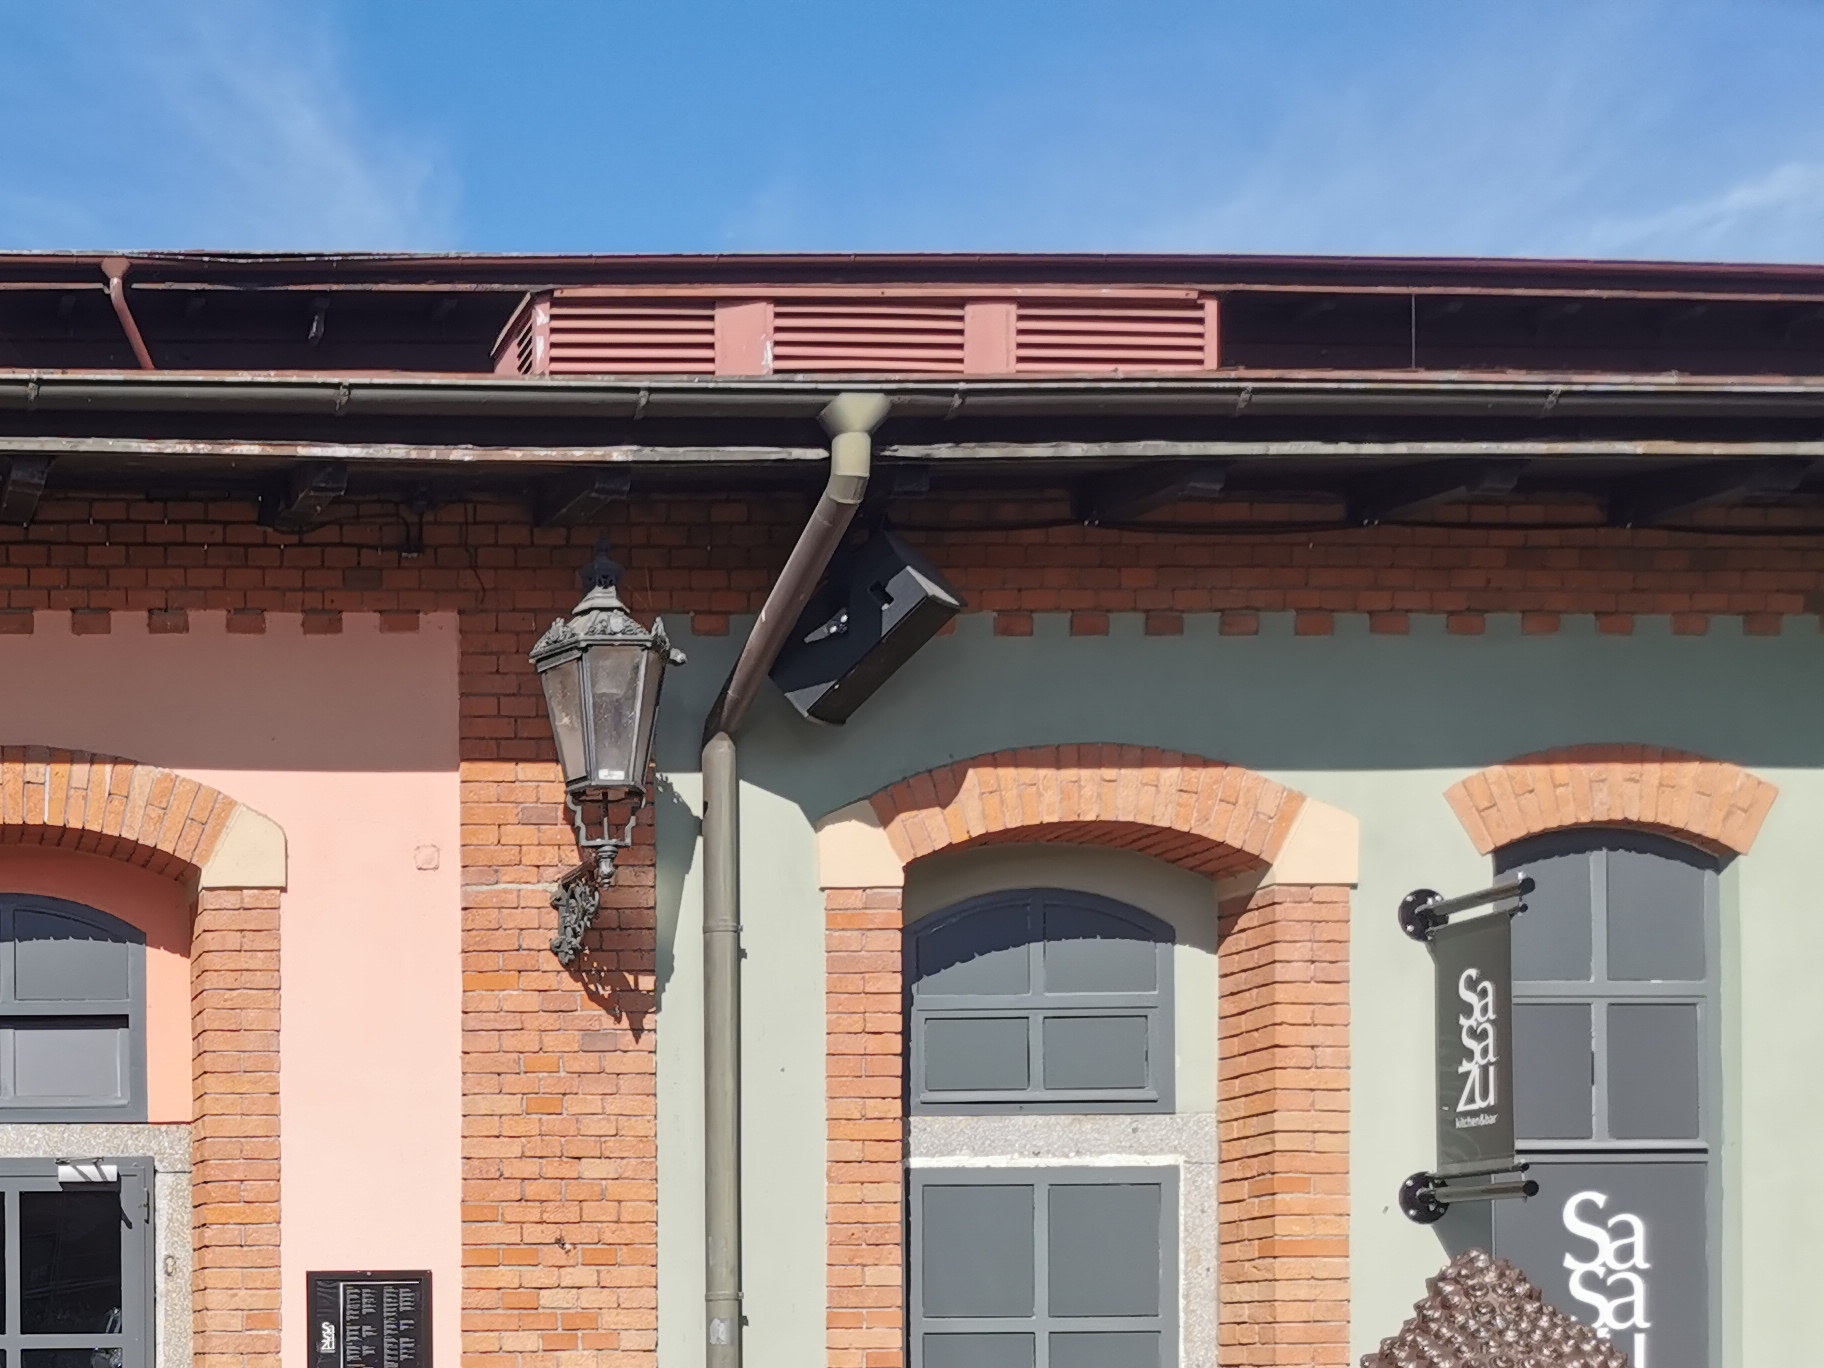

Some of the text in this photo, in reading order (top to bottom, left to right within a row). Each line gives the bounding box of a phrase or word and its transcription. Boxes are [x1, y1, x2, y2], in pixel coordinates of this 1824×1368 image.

[1458, 968, 1498, 1025] Sa
[1455, 1114, 1498, 1128] kitchen&bar
[1562, 1190, 1651, 1270] Sa
